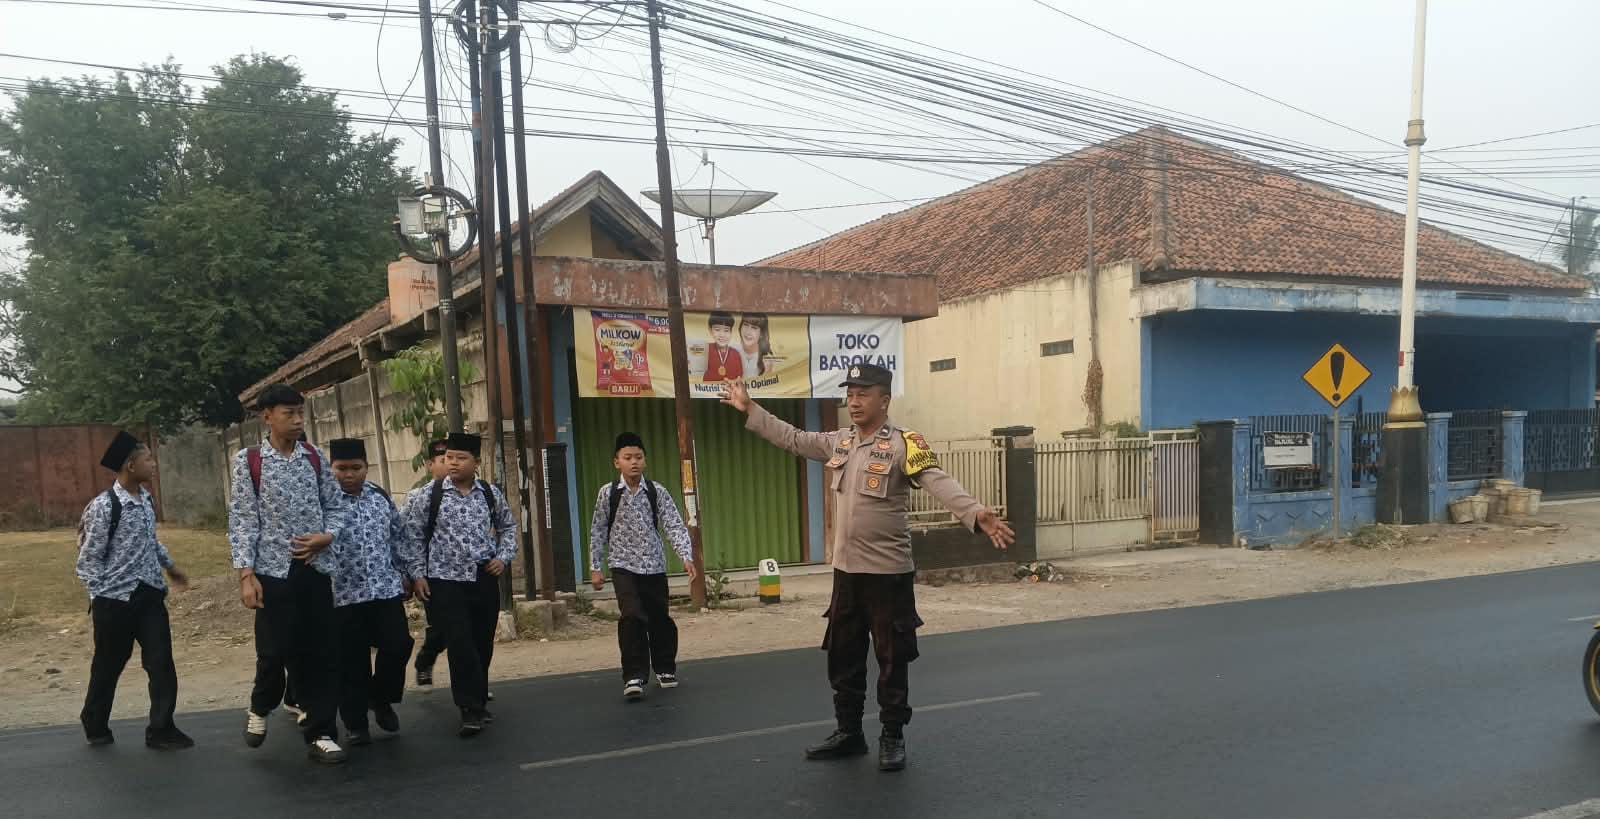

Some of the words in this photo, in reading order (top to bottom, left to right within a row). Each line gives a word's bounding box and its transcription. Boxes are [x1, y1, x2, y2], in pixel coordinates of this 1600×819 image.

[600, 328, 641, 340] MILKOW
[836, 334, 880, 350] TOKO
[819, 354, 896, 371] BAROKAH
[694, 383, 721, 393] Nutrisi
[750, 374, 780, 390] Optimal
[869, 451, 894, 461] POLRI
[766, 561, 776, 573] 8
